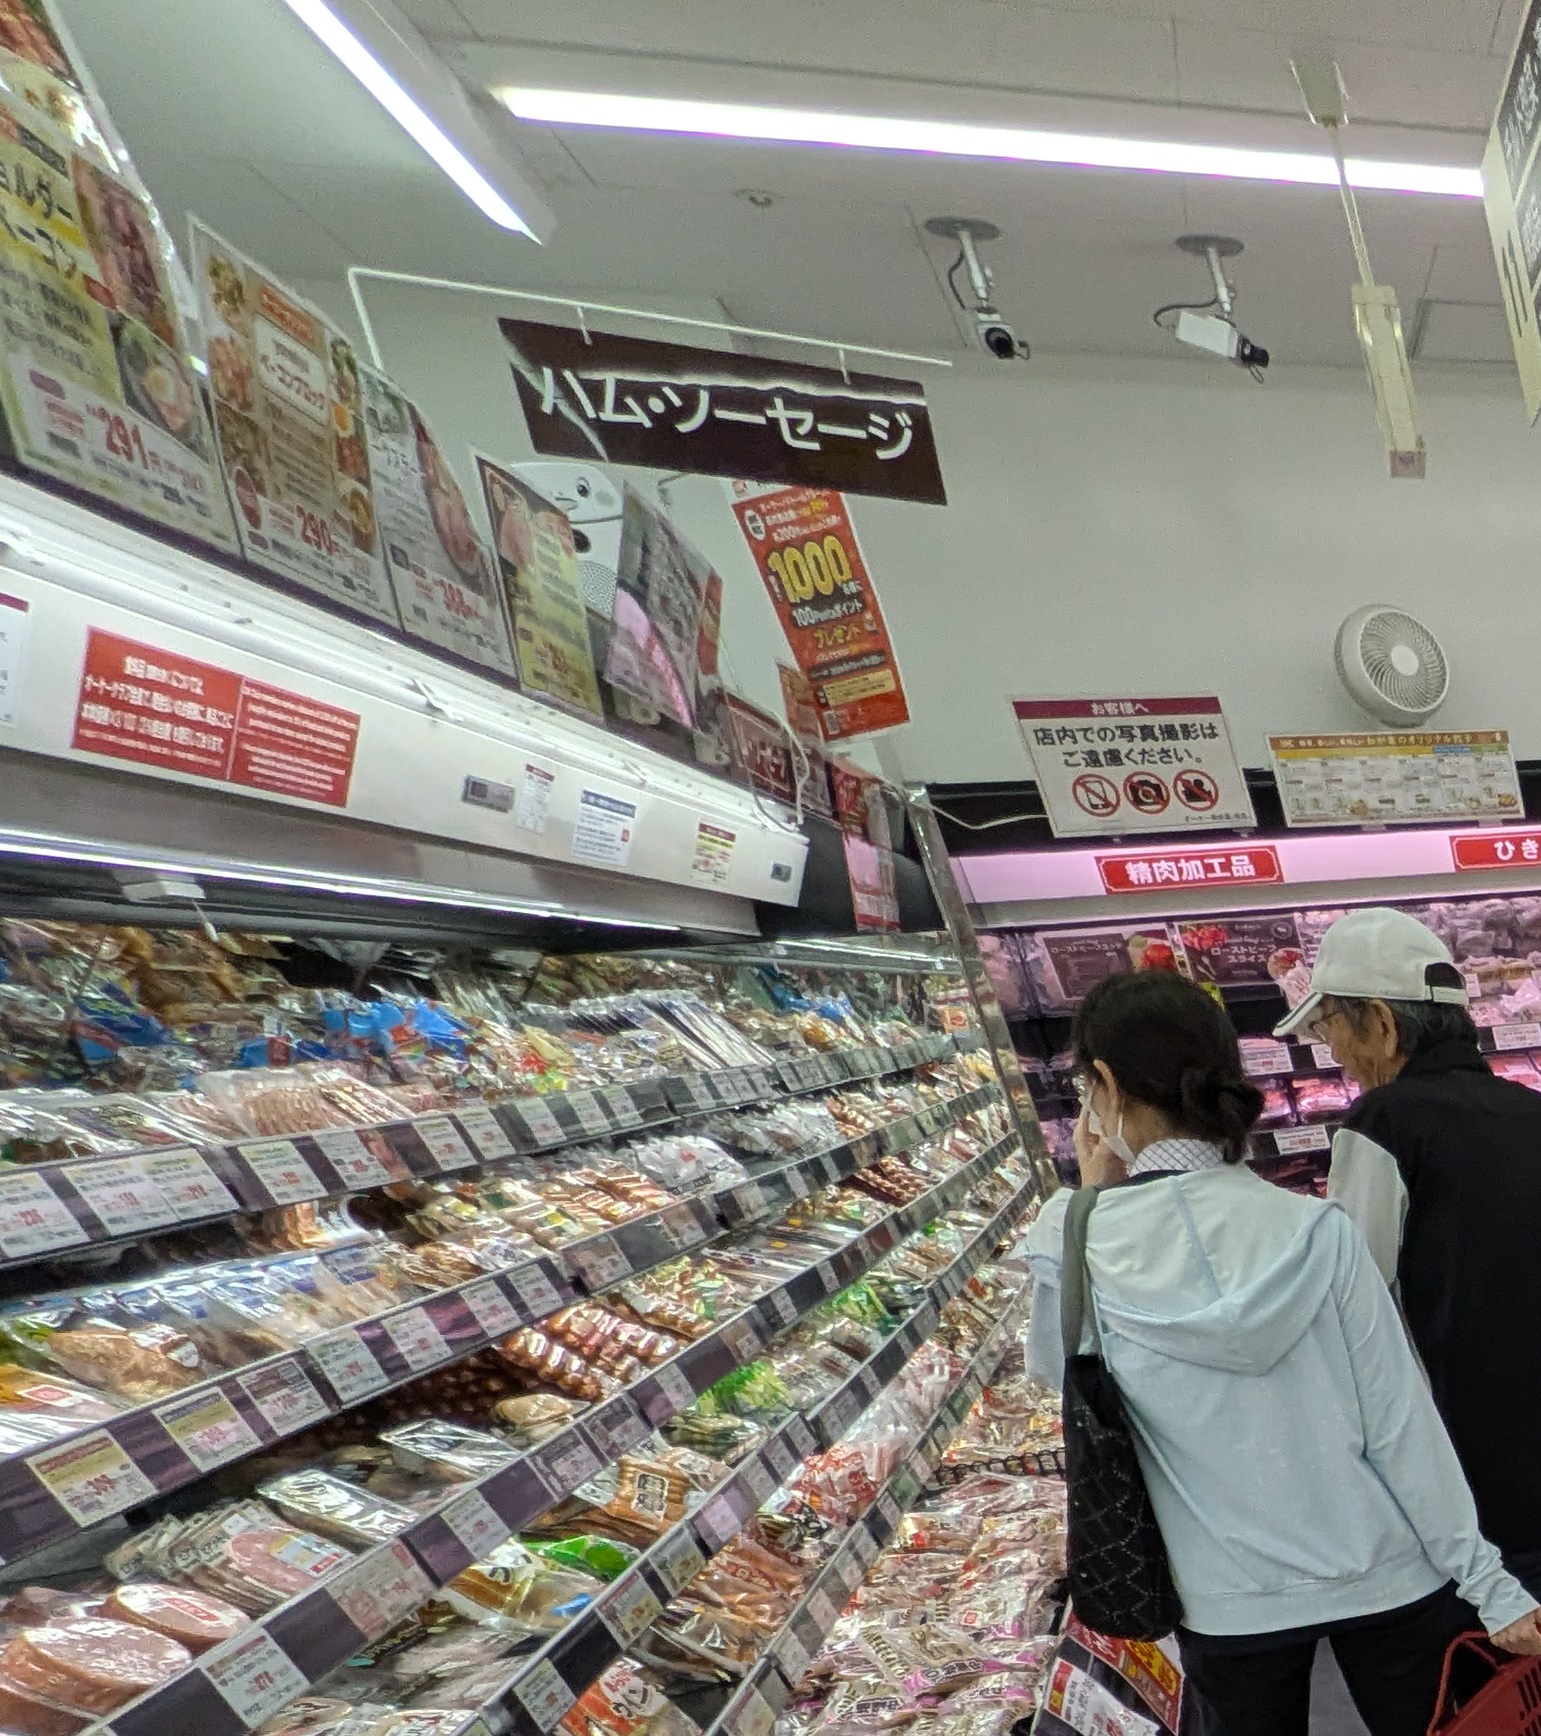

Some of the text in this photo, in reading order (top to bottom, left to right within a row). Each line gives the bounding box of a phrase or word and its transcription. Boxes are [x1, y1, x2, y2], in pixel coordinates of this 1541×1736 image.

[542, 366, 913, 460] ハム・ソーセージ
[767, 535, 852, 604] 1000
[1091, 703, 1150, 716] お客様へ
[1032, 724, 1219, 747] 店内での写真撮影は
[1063, 747, 1203, 768] ご遠慮ください。
[1124, 855, 1256, 885] 精肉加工品
